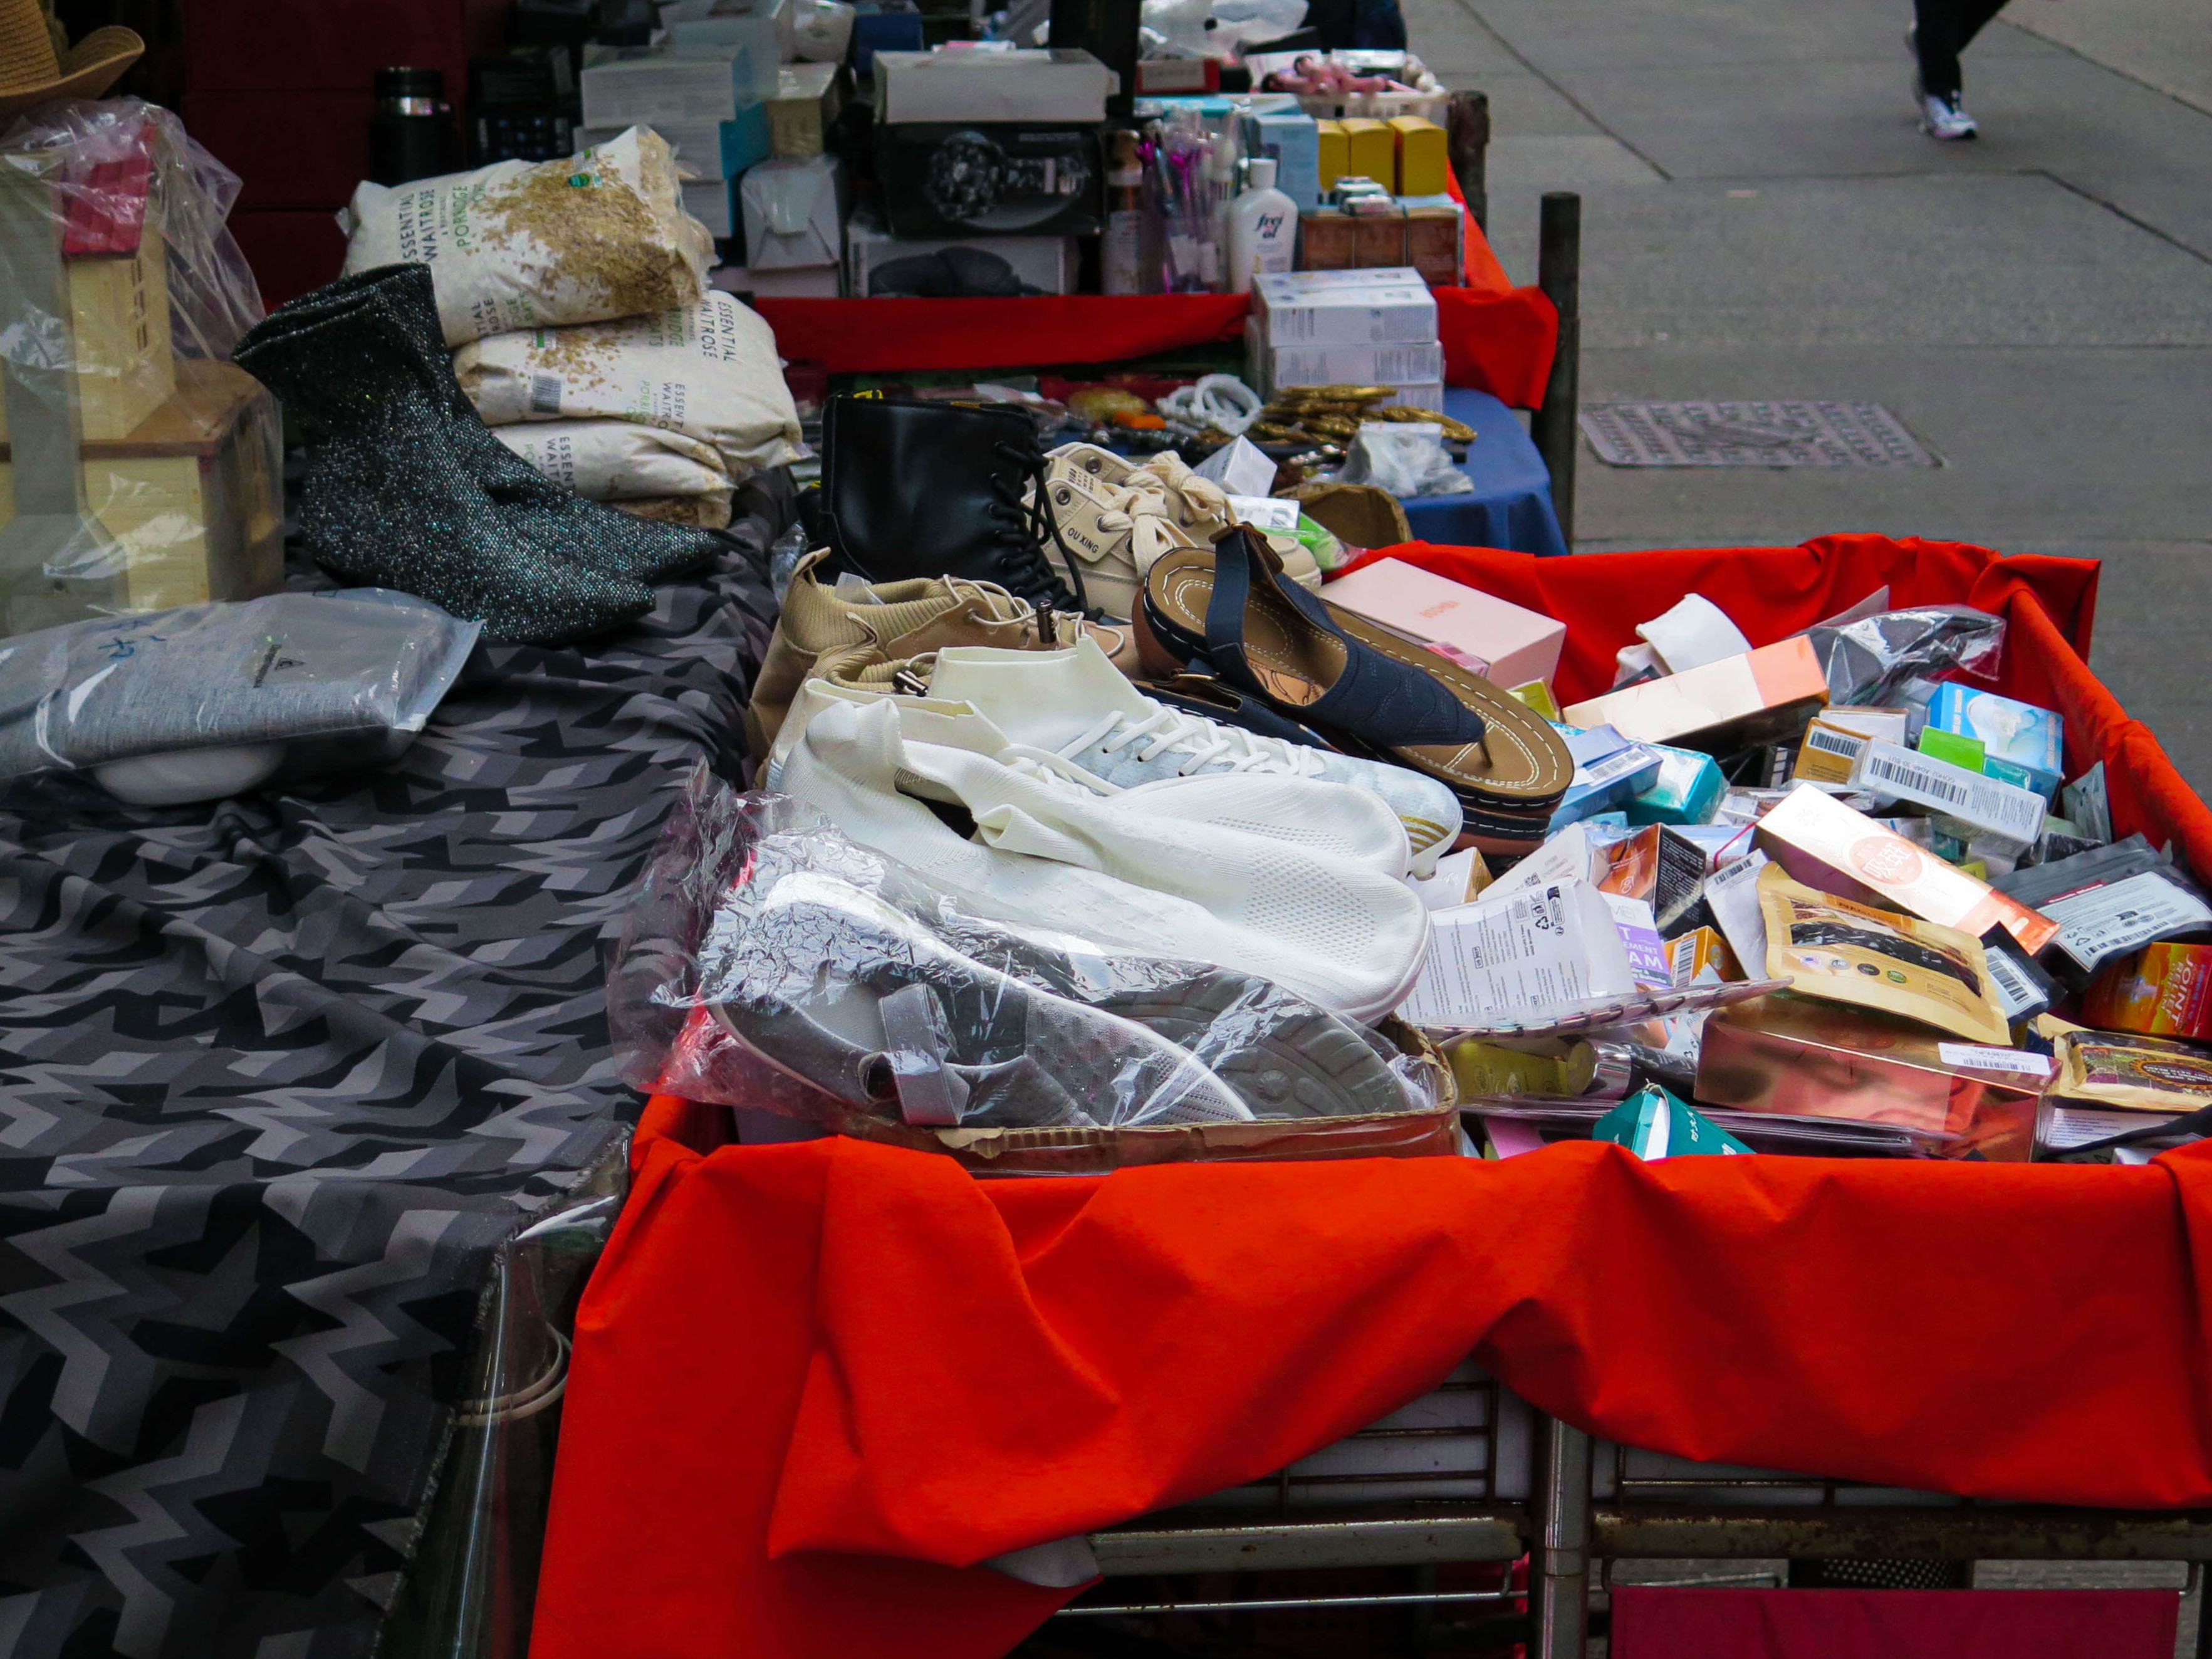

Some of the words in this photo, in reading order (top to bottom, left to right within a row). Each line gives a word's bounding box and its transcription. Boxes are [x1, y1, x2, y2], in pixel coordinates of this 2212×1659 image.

[400, 193, 419, 263] SSENTIAL
[717, 301, 737, 362] ESSENTIAL
[1068, 527, 1081, 540] OU
[1079, 536, 1099, 553] XING
[1629, 951, 1664, 970] AM
[2175, 953, 2194, 1027] JOINT
